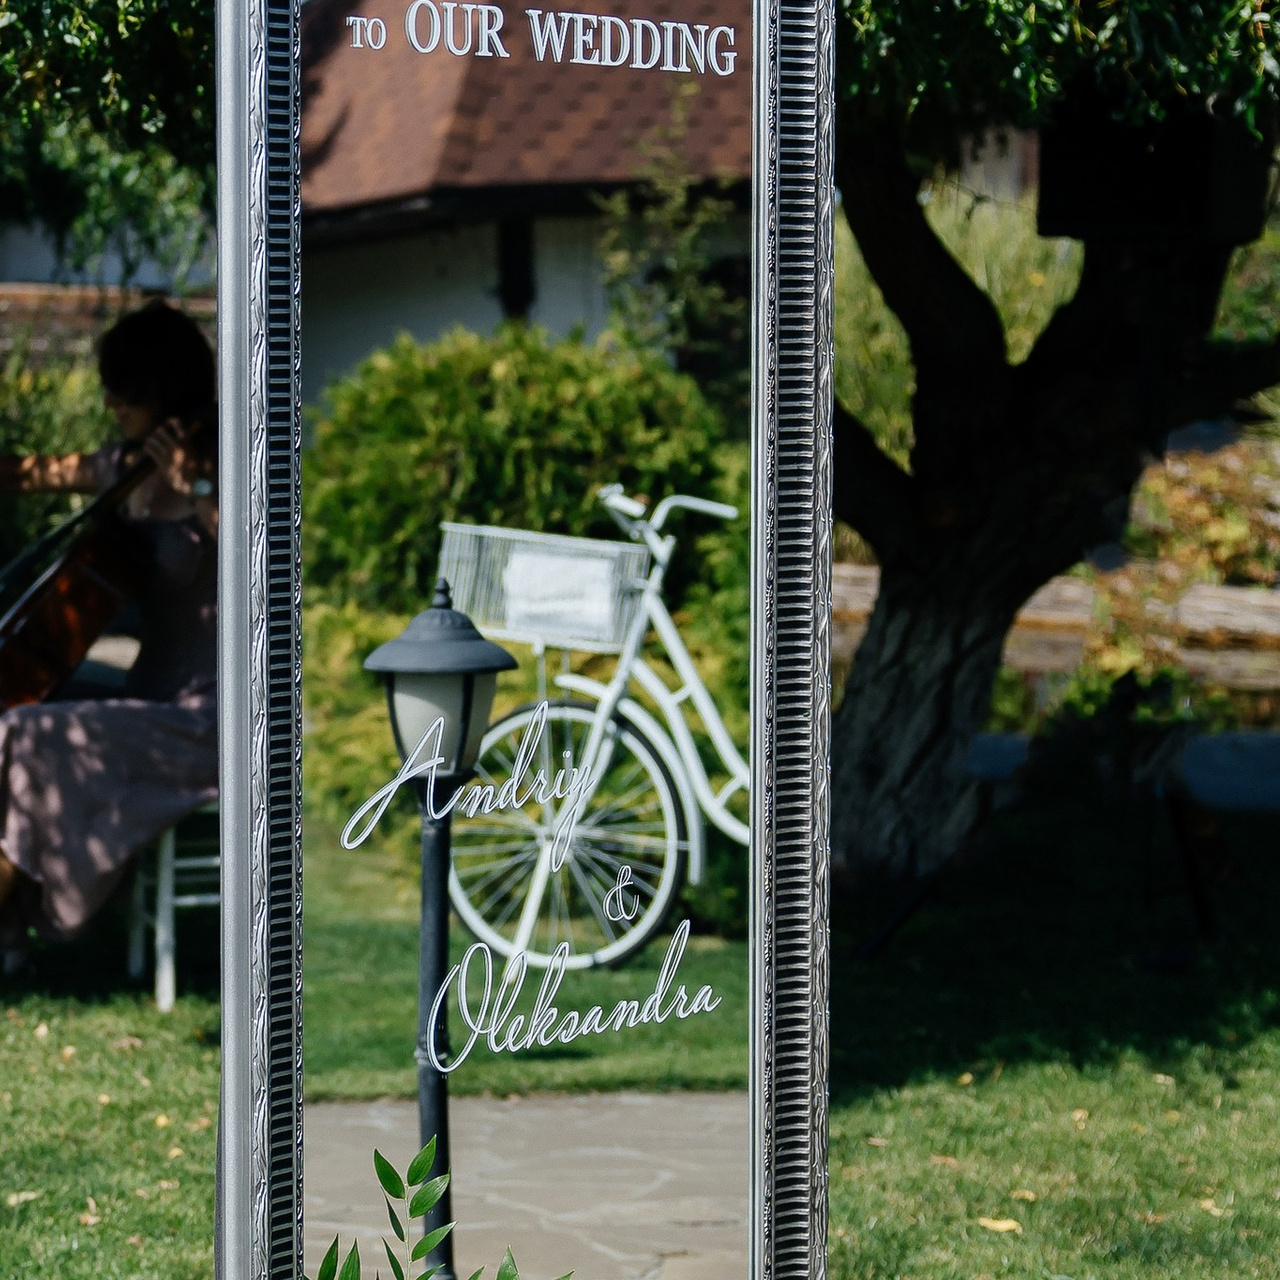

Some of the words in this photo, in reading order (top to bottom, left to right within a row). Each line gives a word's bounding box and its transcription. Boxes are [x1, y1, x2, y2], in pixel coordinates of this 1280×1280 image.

[345, 15, 388, 51] TO
[525, 8, 738, 77] WEDDING
[340, 700, 596, 873] Andriy
[602, 864, 640, 922] &
[426, 918, 723, 1074] Oleksandra
